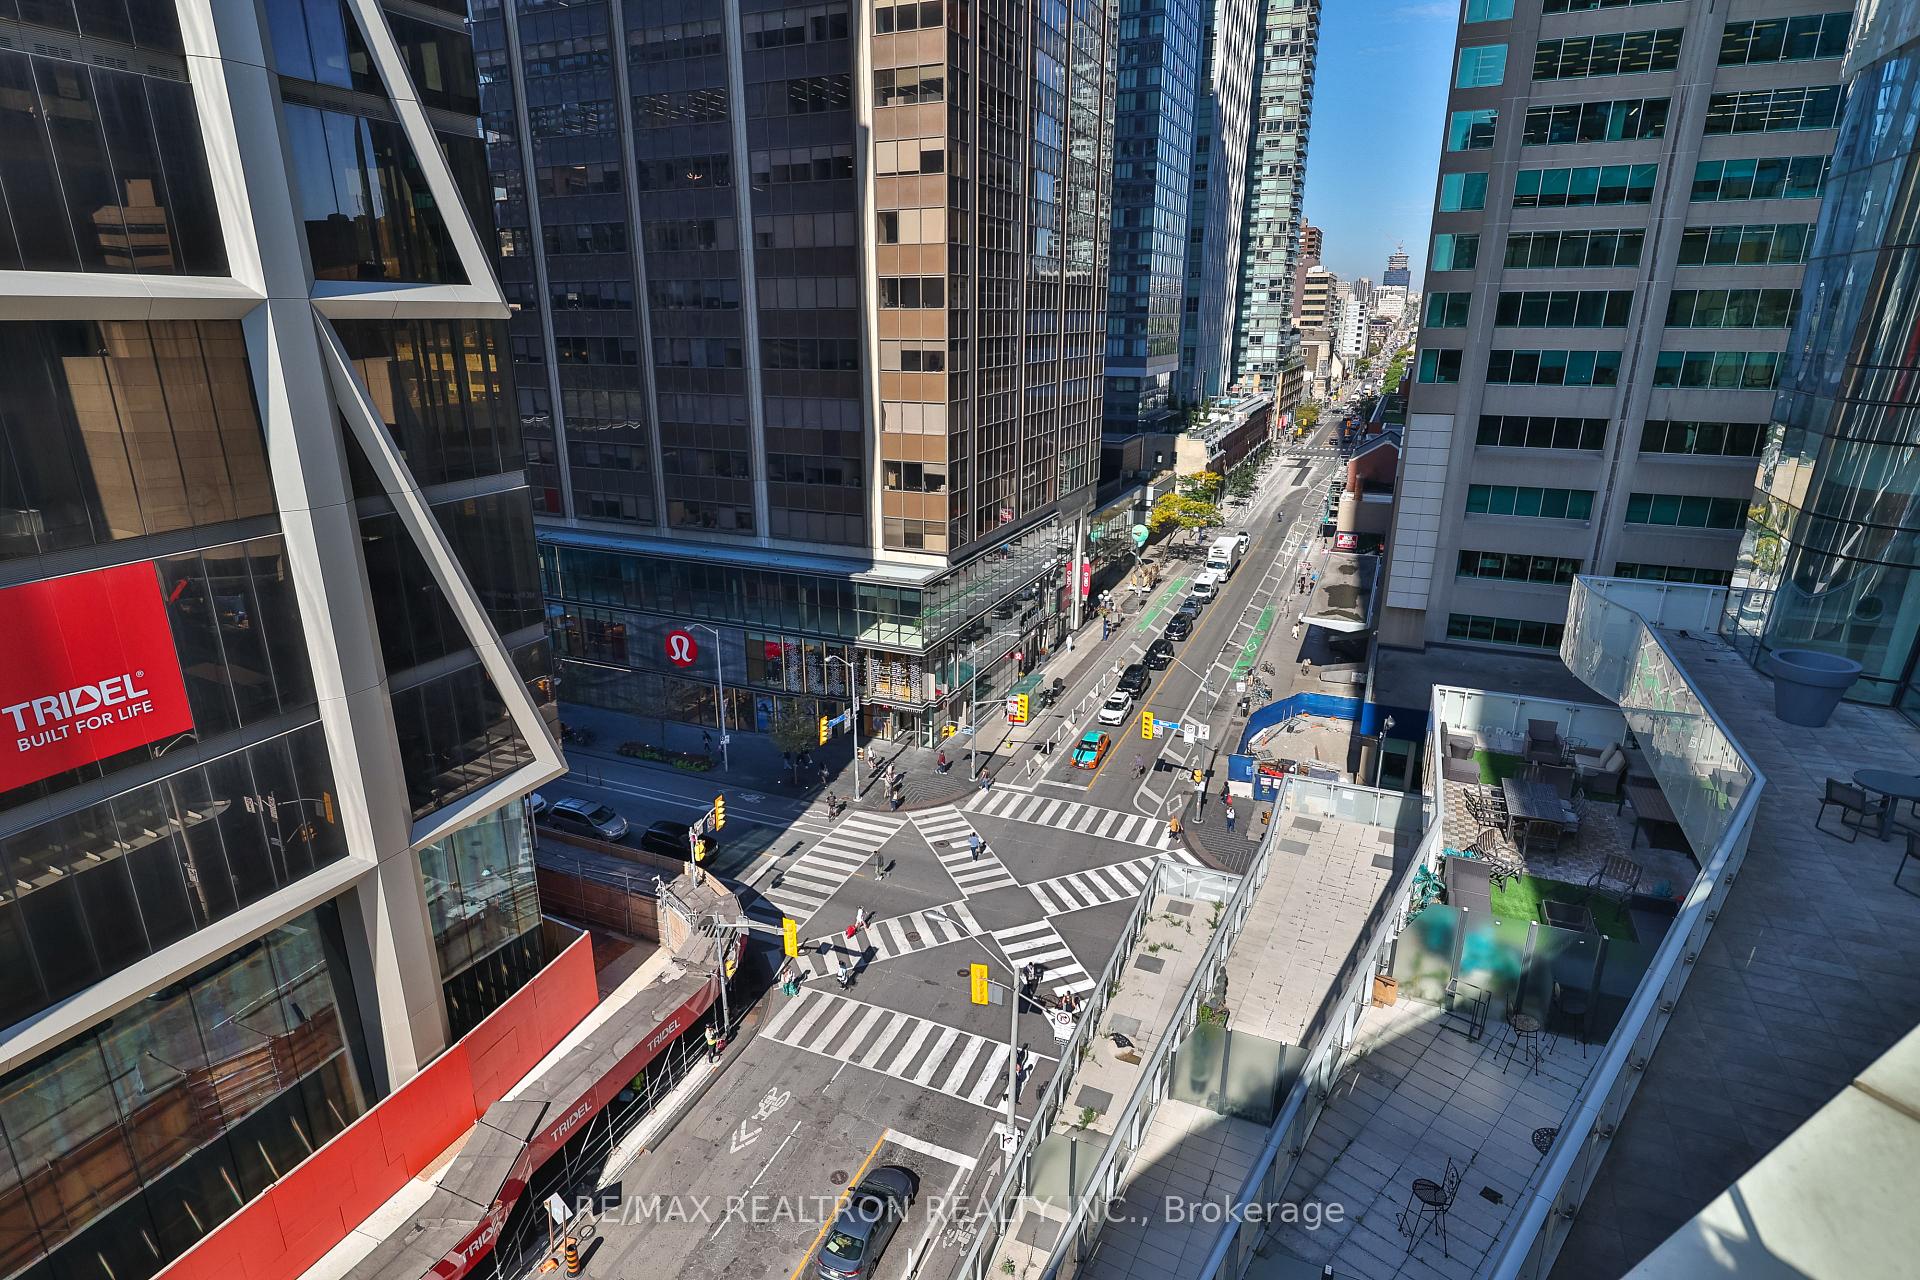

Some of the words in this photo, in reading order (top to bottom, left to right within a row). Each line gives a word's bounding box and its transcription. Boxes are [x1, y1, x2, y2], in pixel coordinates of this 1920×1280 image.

[17, 724, 70, 752] BUILT
[75, 712, 115, 734] FOR
[117, 700, 154, 721] LIFE
[646, 1019, 681, 1052] TRIDEL
[550, 1101, 593, 1142] TRIDEL
